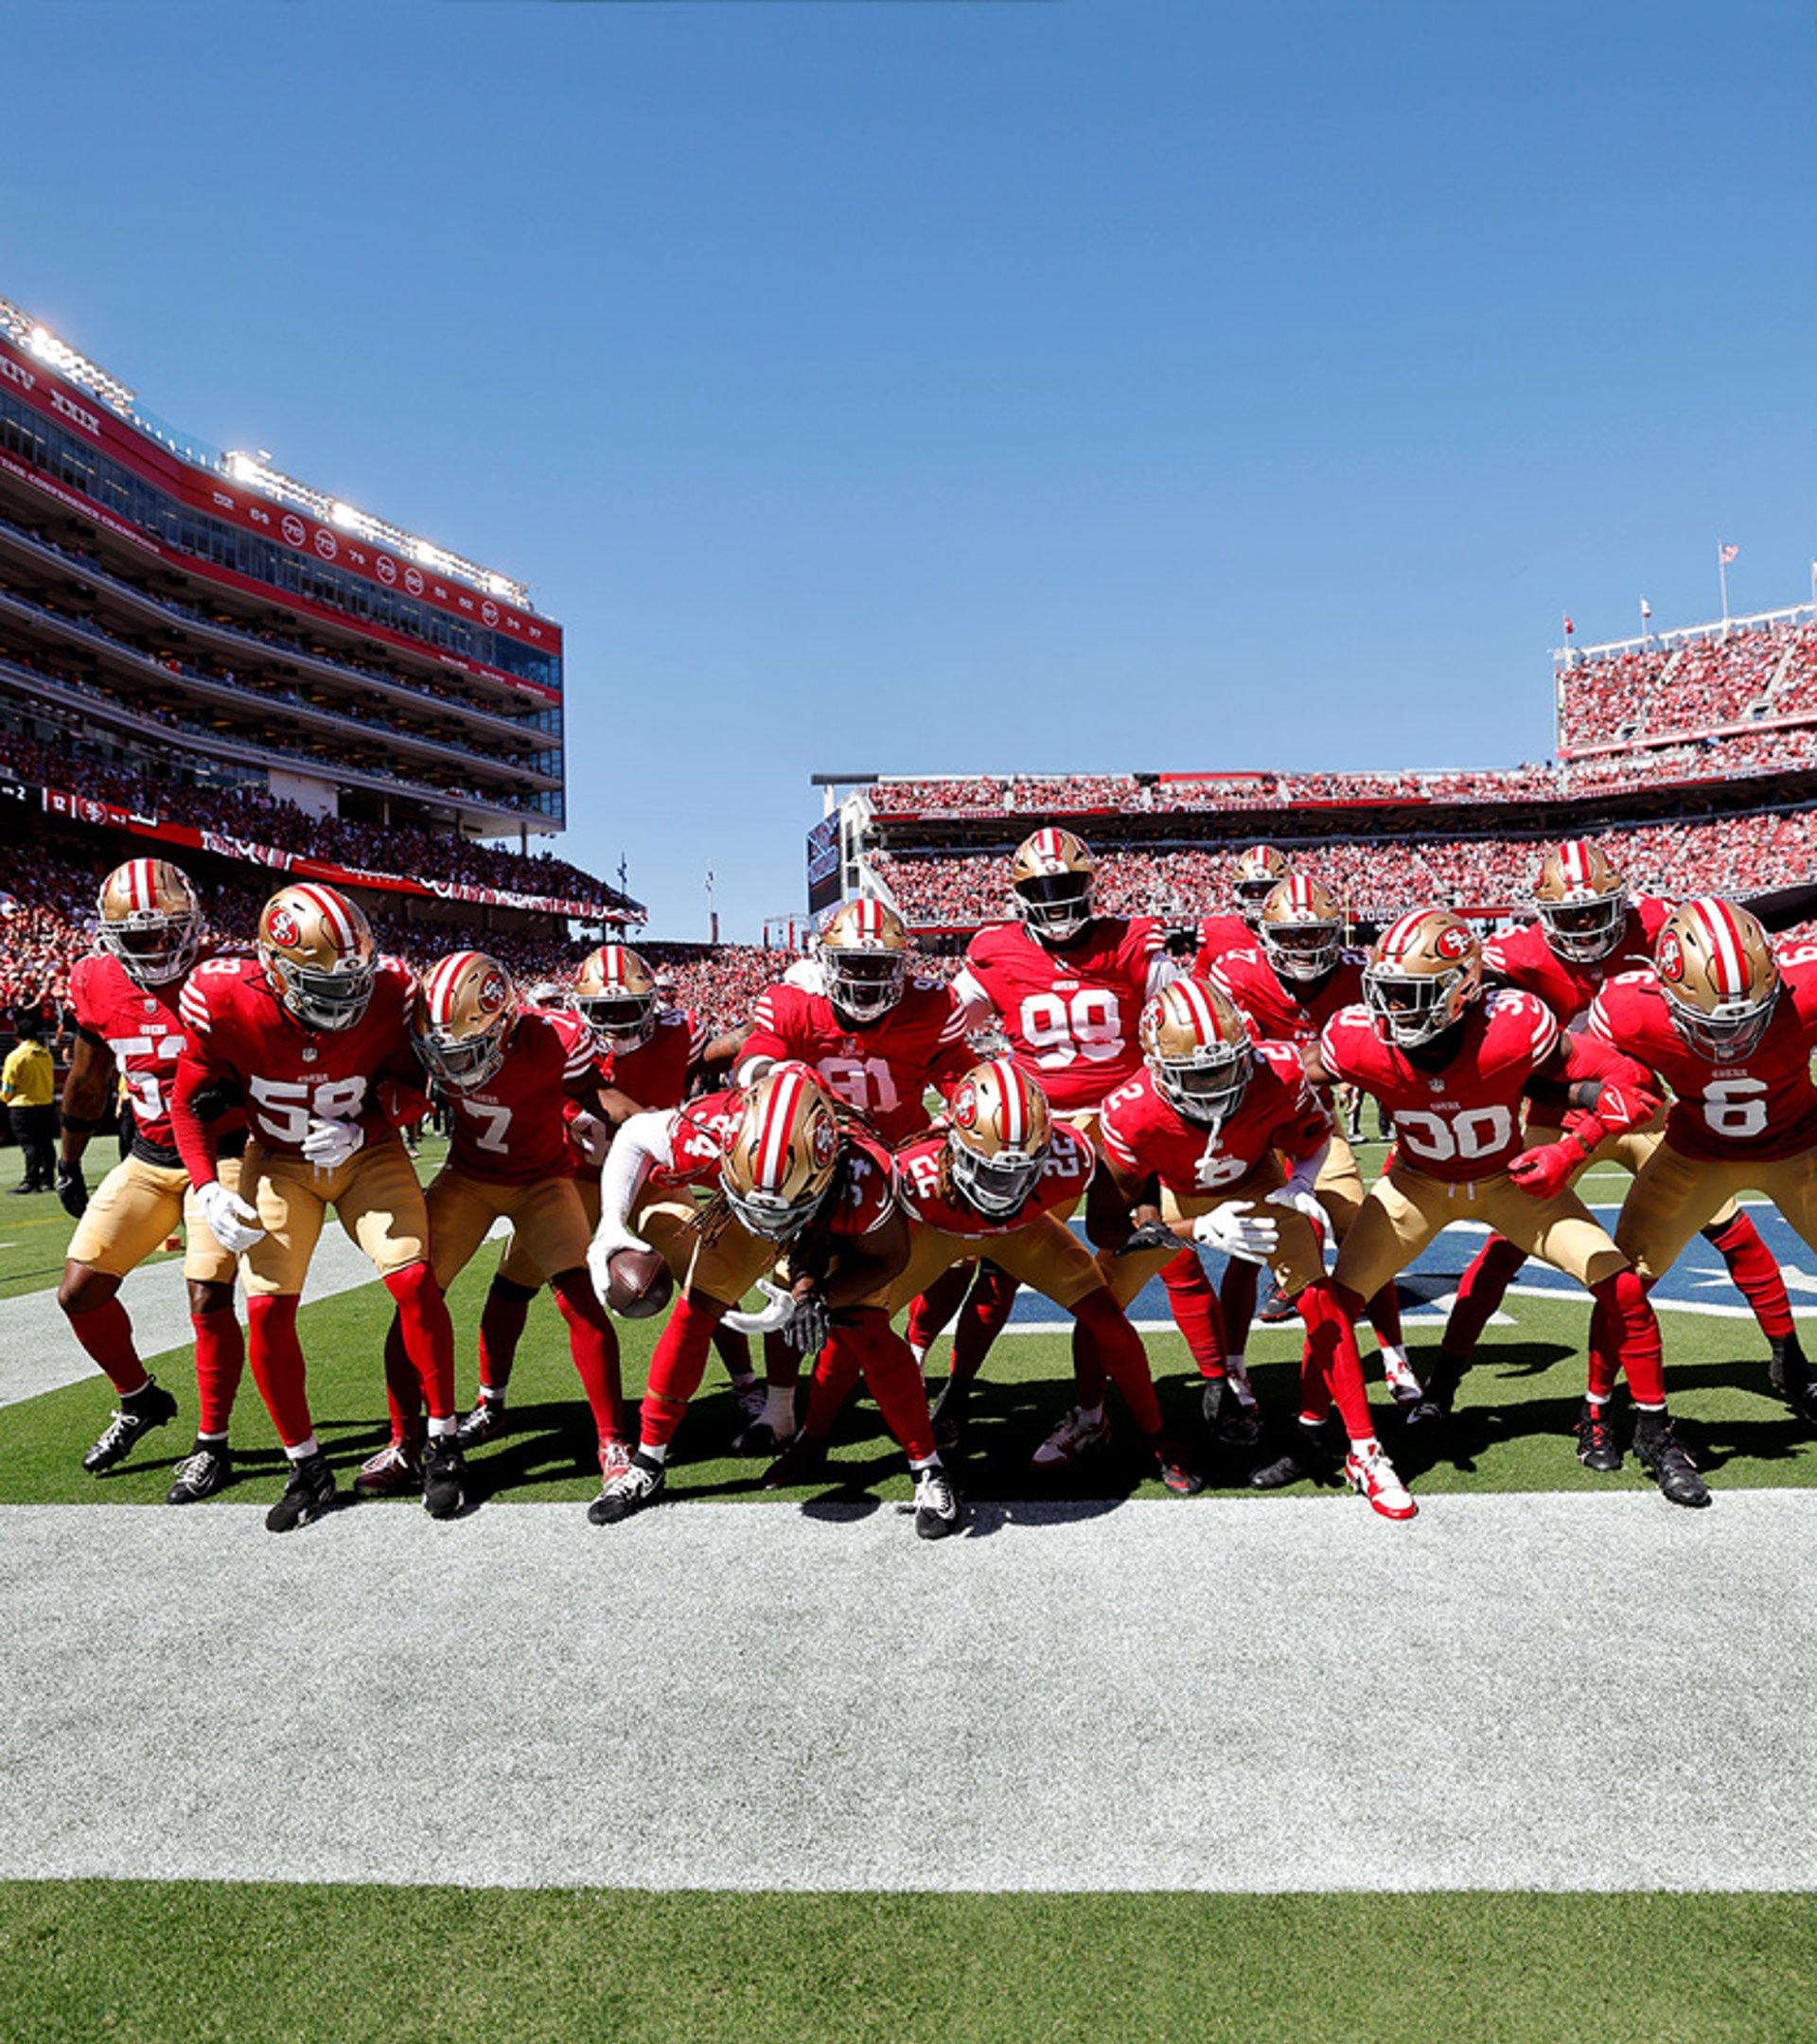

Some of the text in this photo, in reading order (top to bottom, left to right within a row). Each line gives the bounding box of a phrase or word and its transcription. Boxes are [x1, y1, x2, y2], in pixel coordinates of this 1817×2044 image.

[50, 388, 100, 437] XXIX
[1020, 989, 1125, 1069] 99
[249, 1075, 367, 1142] 58
[816, 1057, 902, 1114] 91
[1702, 1078, 1769, 1137] 6
[462, 1098, 513, 1154] 7
[1393, 1105, 1512, 1162] 30
